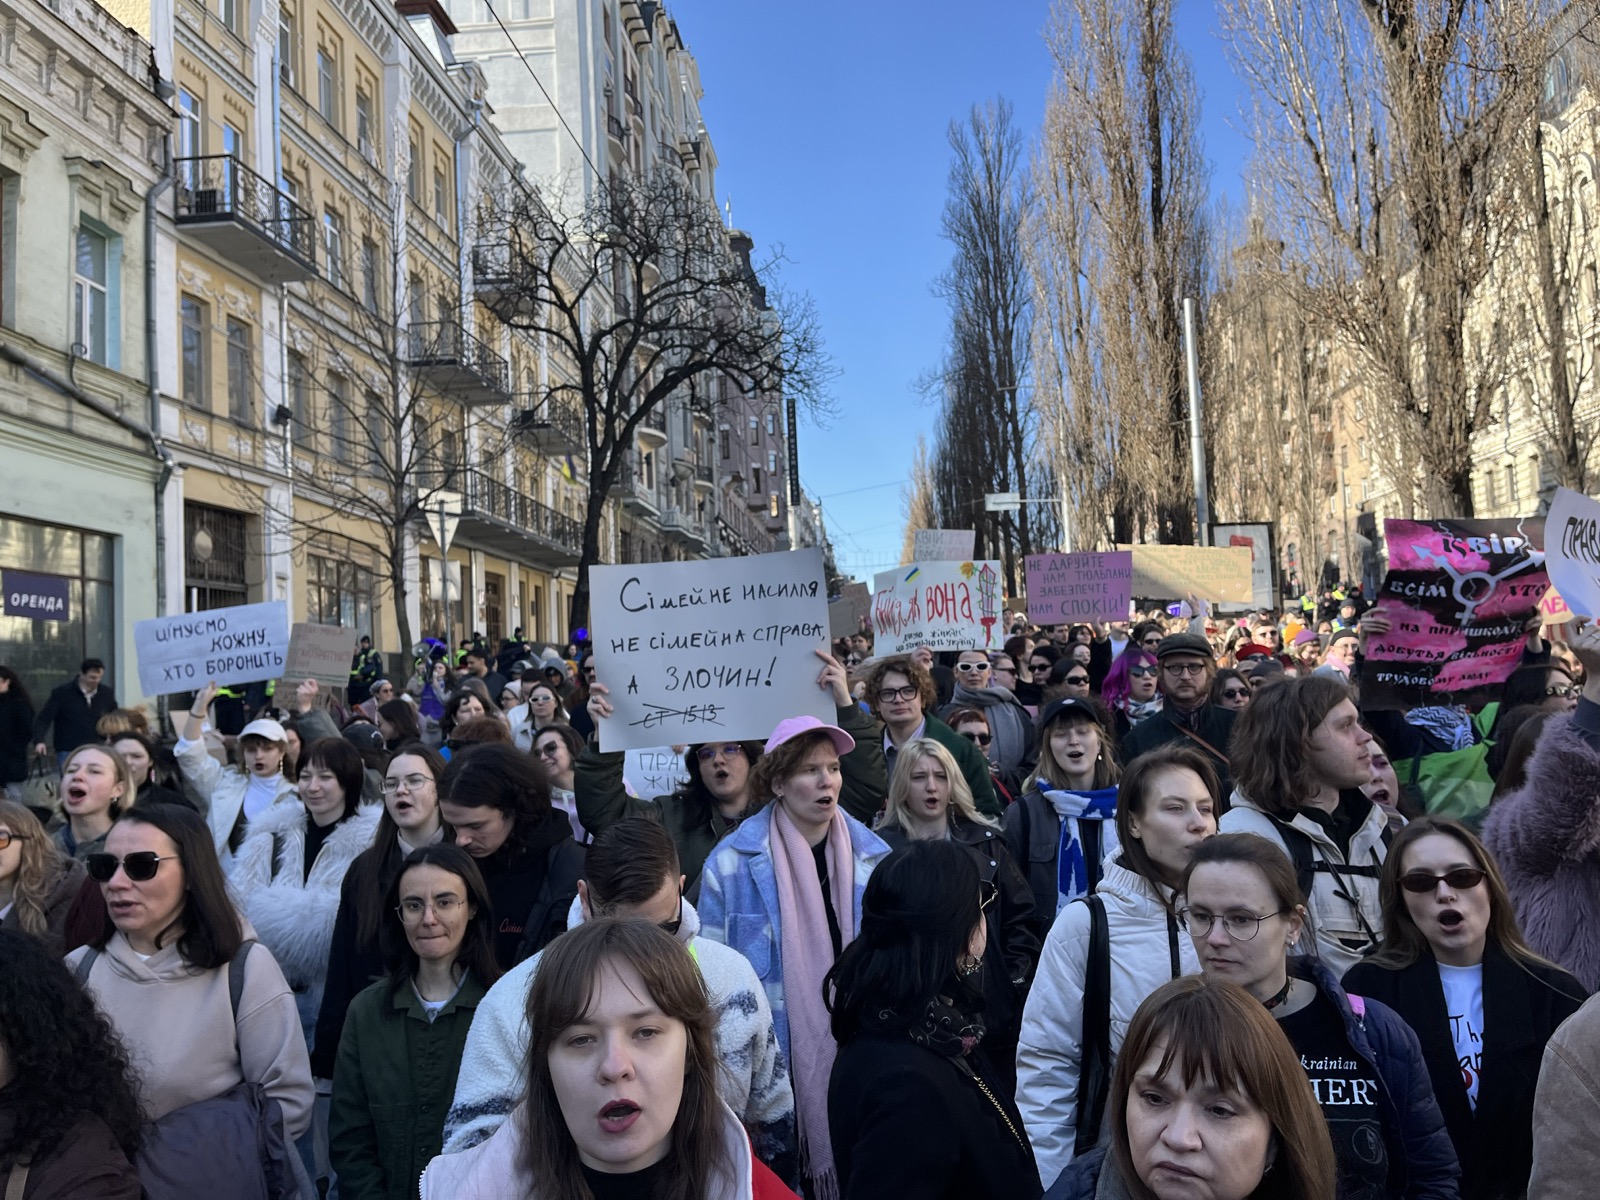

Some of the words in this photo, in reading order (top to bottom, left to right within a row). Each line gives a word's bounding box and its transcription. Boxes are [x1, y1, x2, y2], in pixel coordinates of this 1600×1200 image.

[1562, 516, 1600, 565] ПРАВ
[1028, 559, 1042, 571] НЕ
[1048, 554, 1104, 571] ДАРУЙТЕ
[1043, 572, 1066, 584] НАМ
[1075, 568, 1131, 581] ТЮЛЬПАНИ
[1039, 583, 1108, 598] ЗАБЕЗПЕЧТЕ
[10, 592, 64, 613] ОРЕНДА
[1030, 603, 1053, 615] НАМ
[1399, 622, 1420, 633] НА
[210, 627, 271, 653] КОЖНУ,
[611, 637, 640, 654] НЕ
[163, 663, 195, 682] ХТО
[205, 651, 283, 676] БОРОНИТЬ
[627, 674, 638, 695] А
[664, 656, 777, 692] ЗЛОЧИН!
[639, 752, 680, 772] ПРА
[643, 774, 685, 793] ЖІН
[1300, 1054, 1358, 1071] krainian
